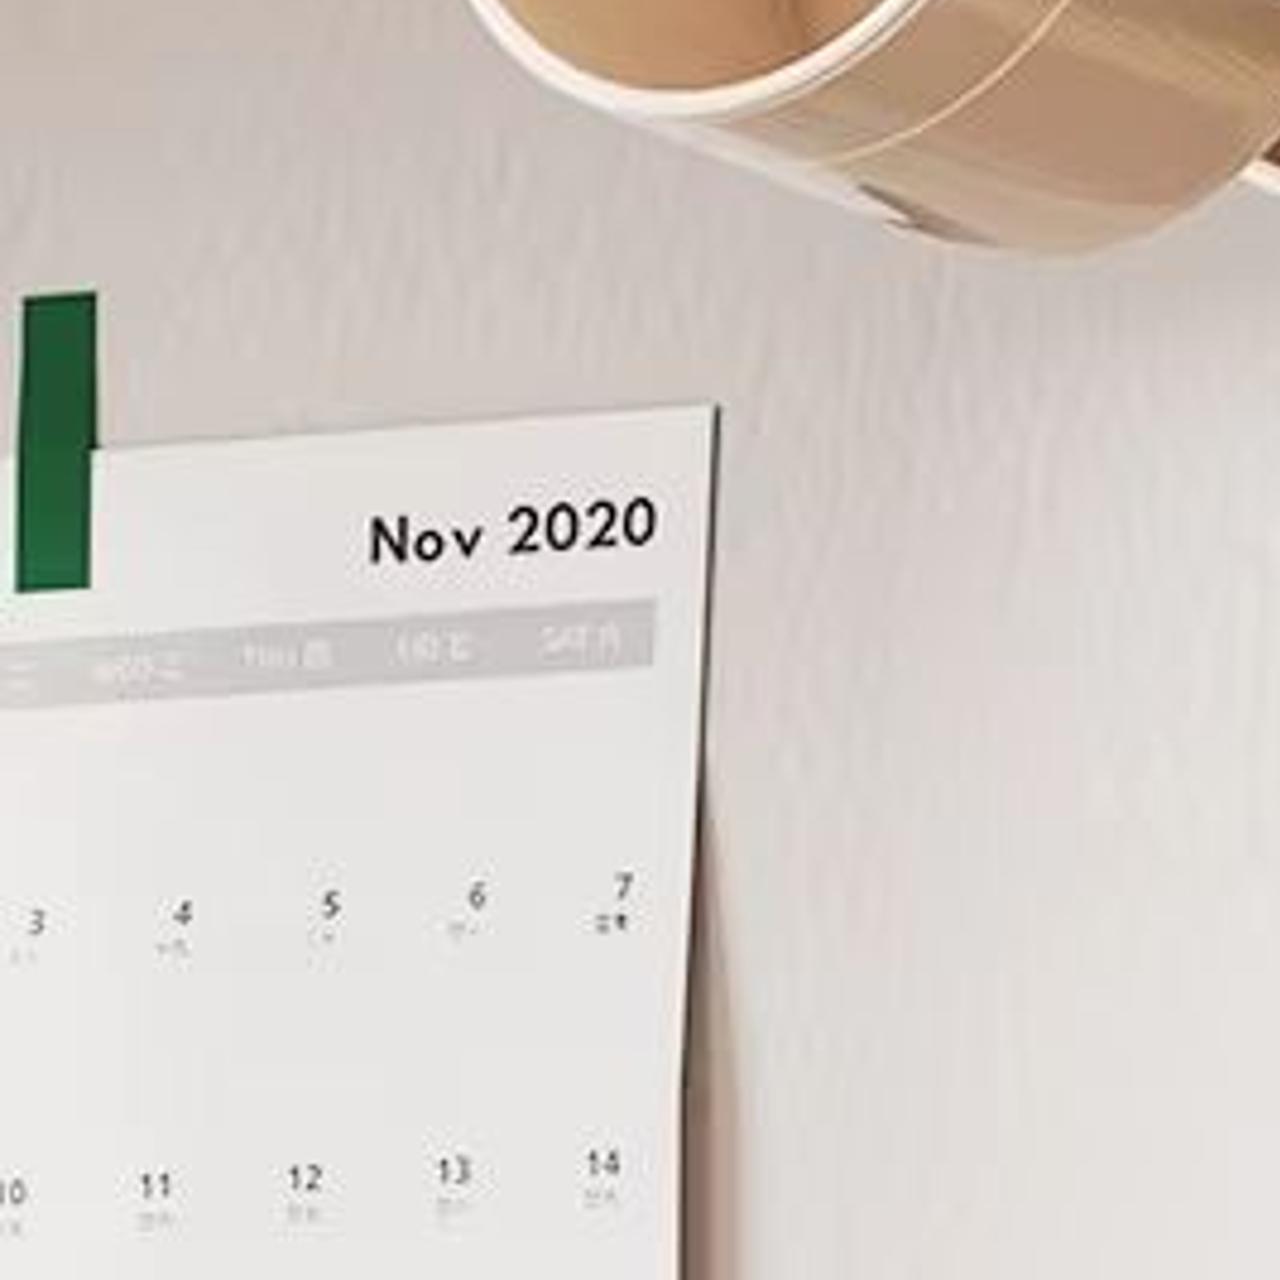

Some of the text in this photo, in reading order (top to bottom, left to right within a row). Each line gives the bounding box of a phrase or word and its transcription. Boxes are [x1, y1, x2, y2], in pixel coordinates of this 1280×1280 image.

[369, 495, 658, 565] Nov 2020
[28, 870, 634, 937] 3 4 5 6 7
[141, 1171, 170, 1200] 11
[288, 1163, 323, 1192] 12
[436, 1155, 471, 1185] 13
[586, 1148, 621, 1177] 14
